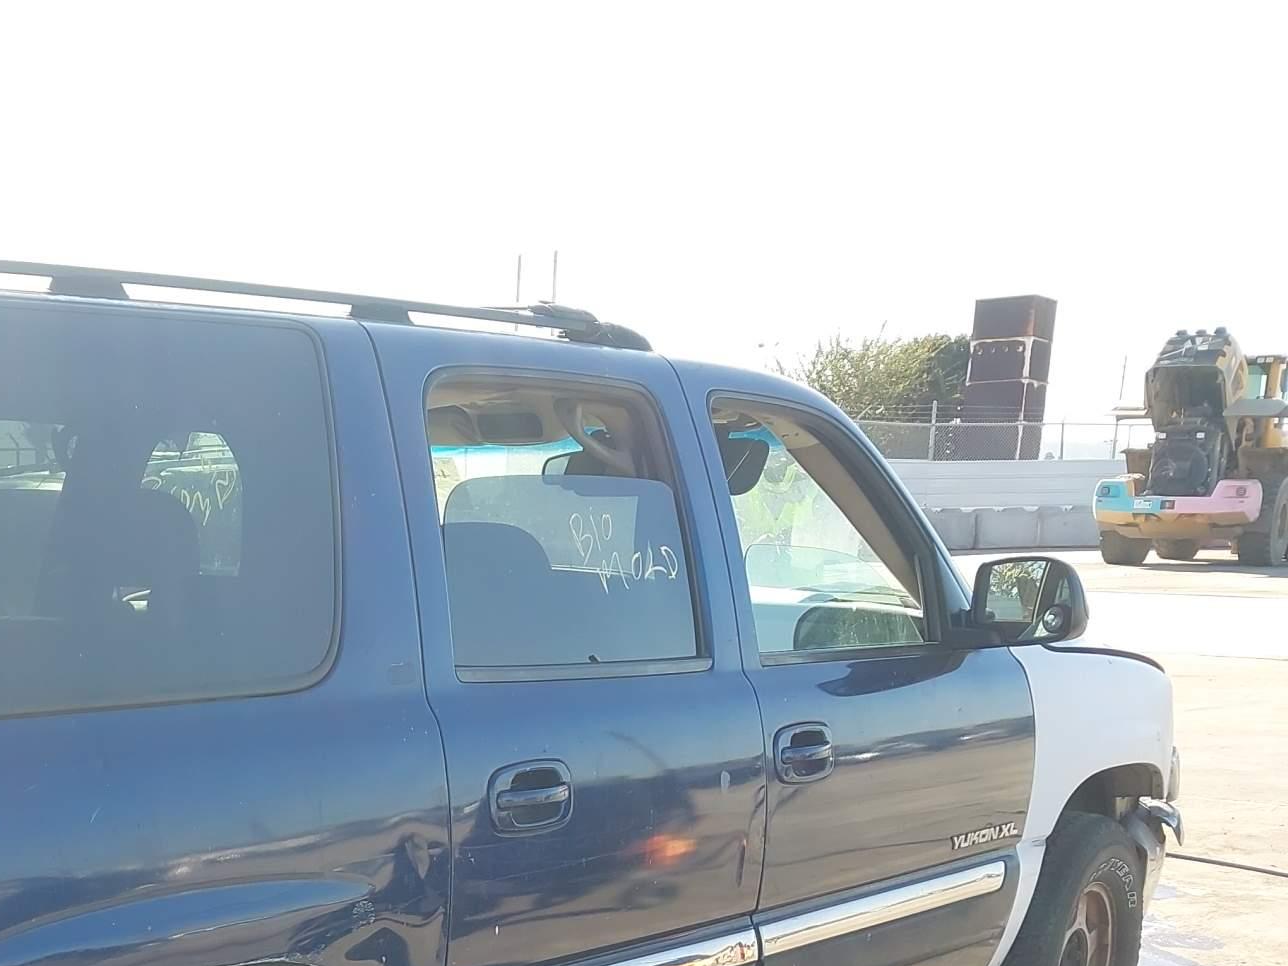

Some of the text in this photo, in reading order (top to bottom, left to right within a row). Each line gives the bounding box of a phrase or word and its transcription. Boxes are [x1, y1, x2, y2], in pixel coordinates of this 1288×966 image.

[597, 540, 678, 594] MOLD
[951, 821, 1019, 850] YUKON XL
